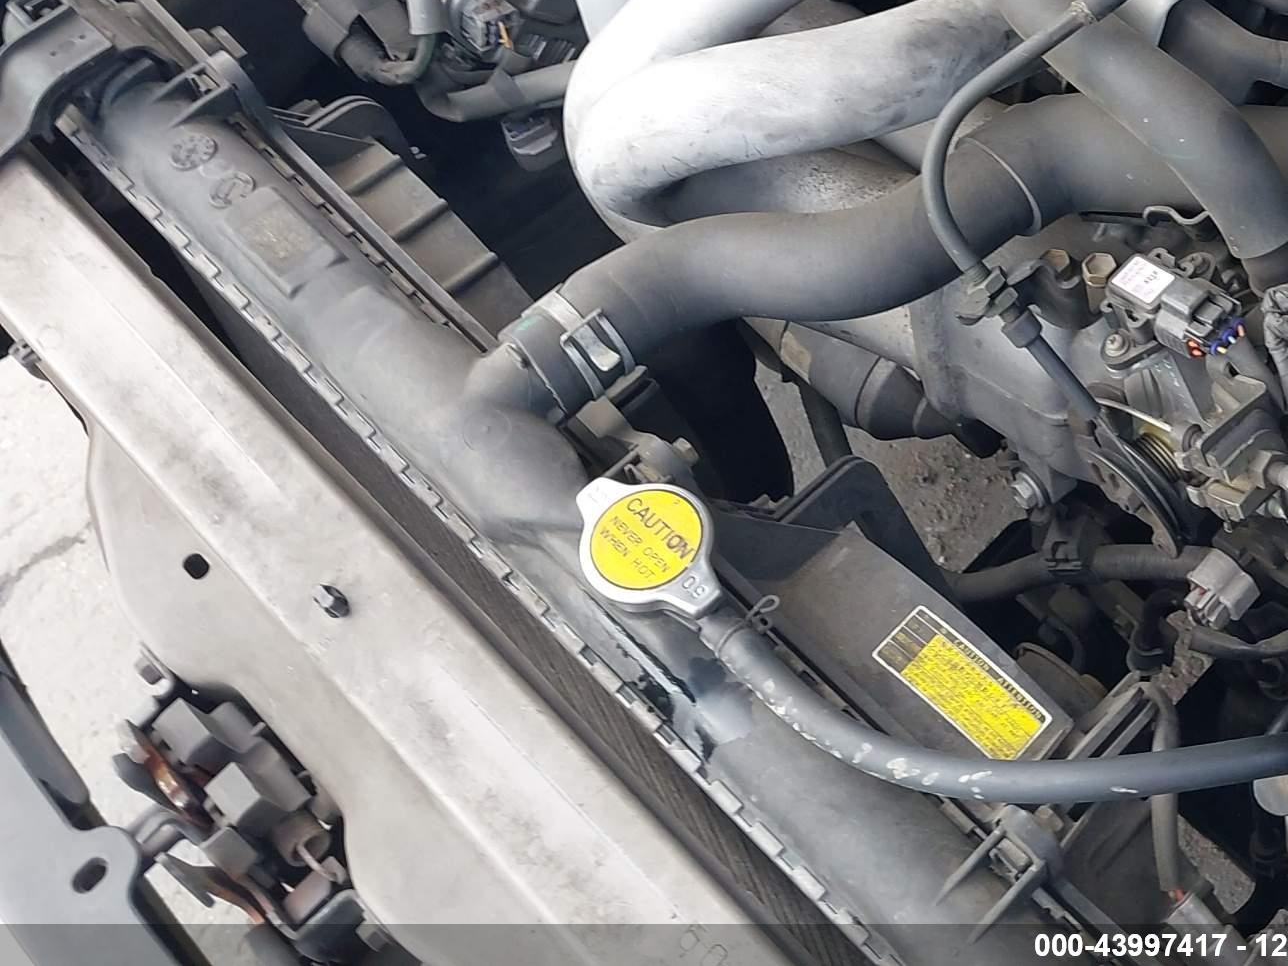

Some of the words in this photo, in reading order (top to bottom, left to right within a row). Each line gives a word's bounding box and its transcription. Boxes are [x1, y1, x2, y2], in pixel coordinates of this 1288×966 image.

[599, 527, 629, 557] WHEN
[608, 514, 643, 546] NEVER
[641, 545, 671, 573] OPEN
[625, 495, 694, 558] CAUTION
